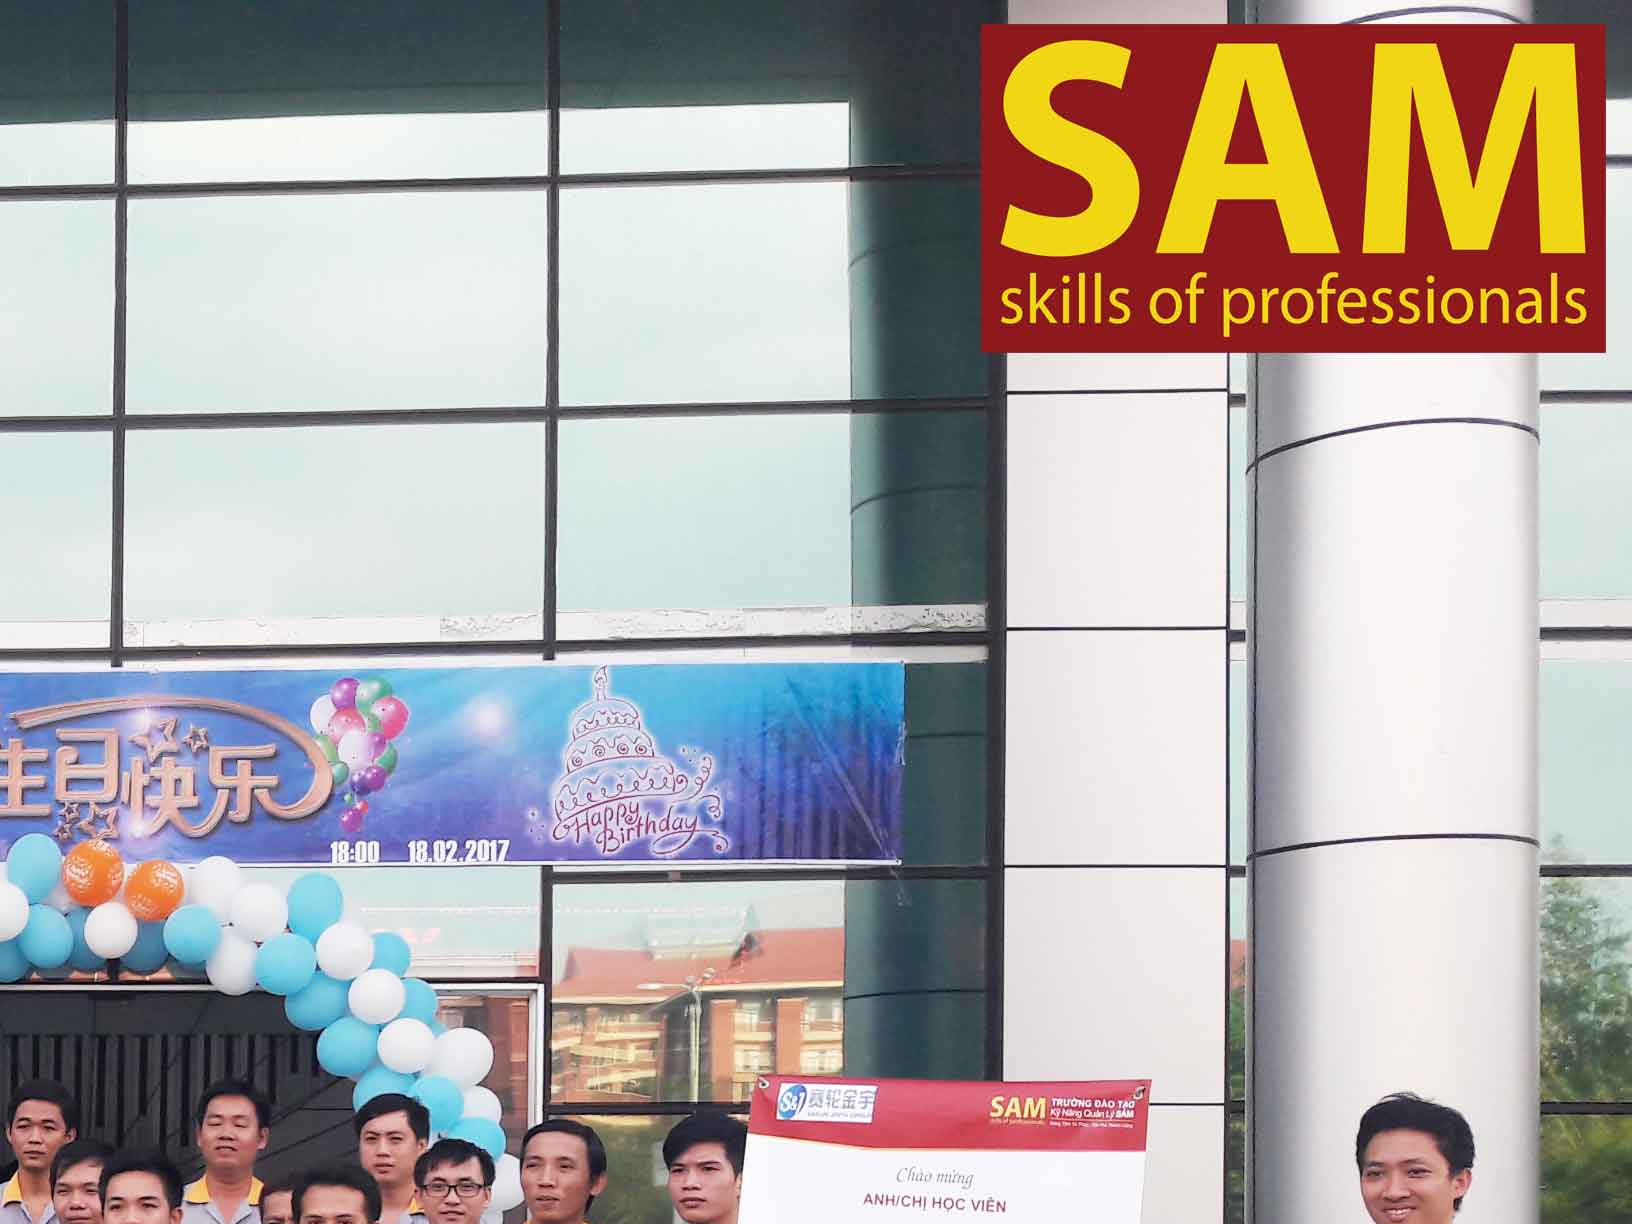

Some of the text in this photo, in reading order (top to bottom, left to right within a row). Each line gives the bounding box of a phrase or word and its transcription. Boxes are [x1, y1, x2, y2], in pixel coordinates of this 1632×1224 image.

[564, 801, 640, 843] Happy
[595, 805, 698, 854] Birthday
[330, 839, 510, 864] 18:00 18.02.2017
[989, 1095, 1047, 1119] SAM
[896, 1165, 974, 1190] Chào mừng
[863, 1193, 1007, 1213] ANH/CHỊ HỌC VIÊN
